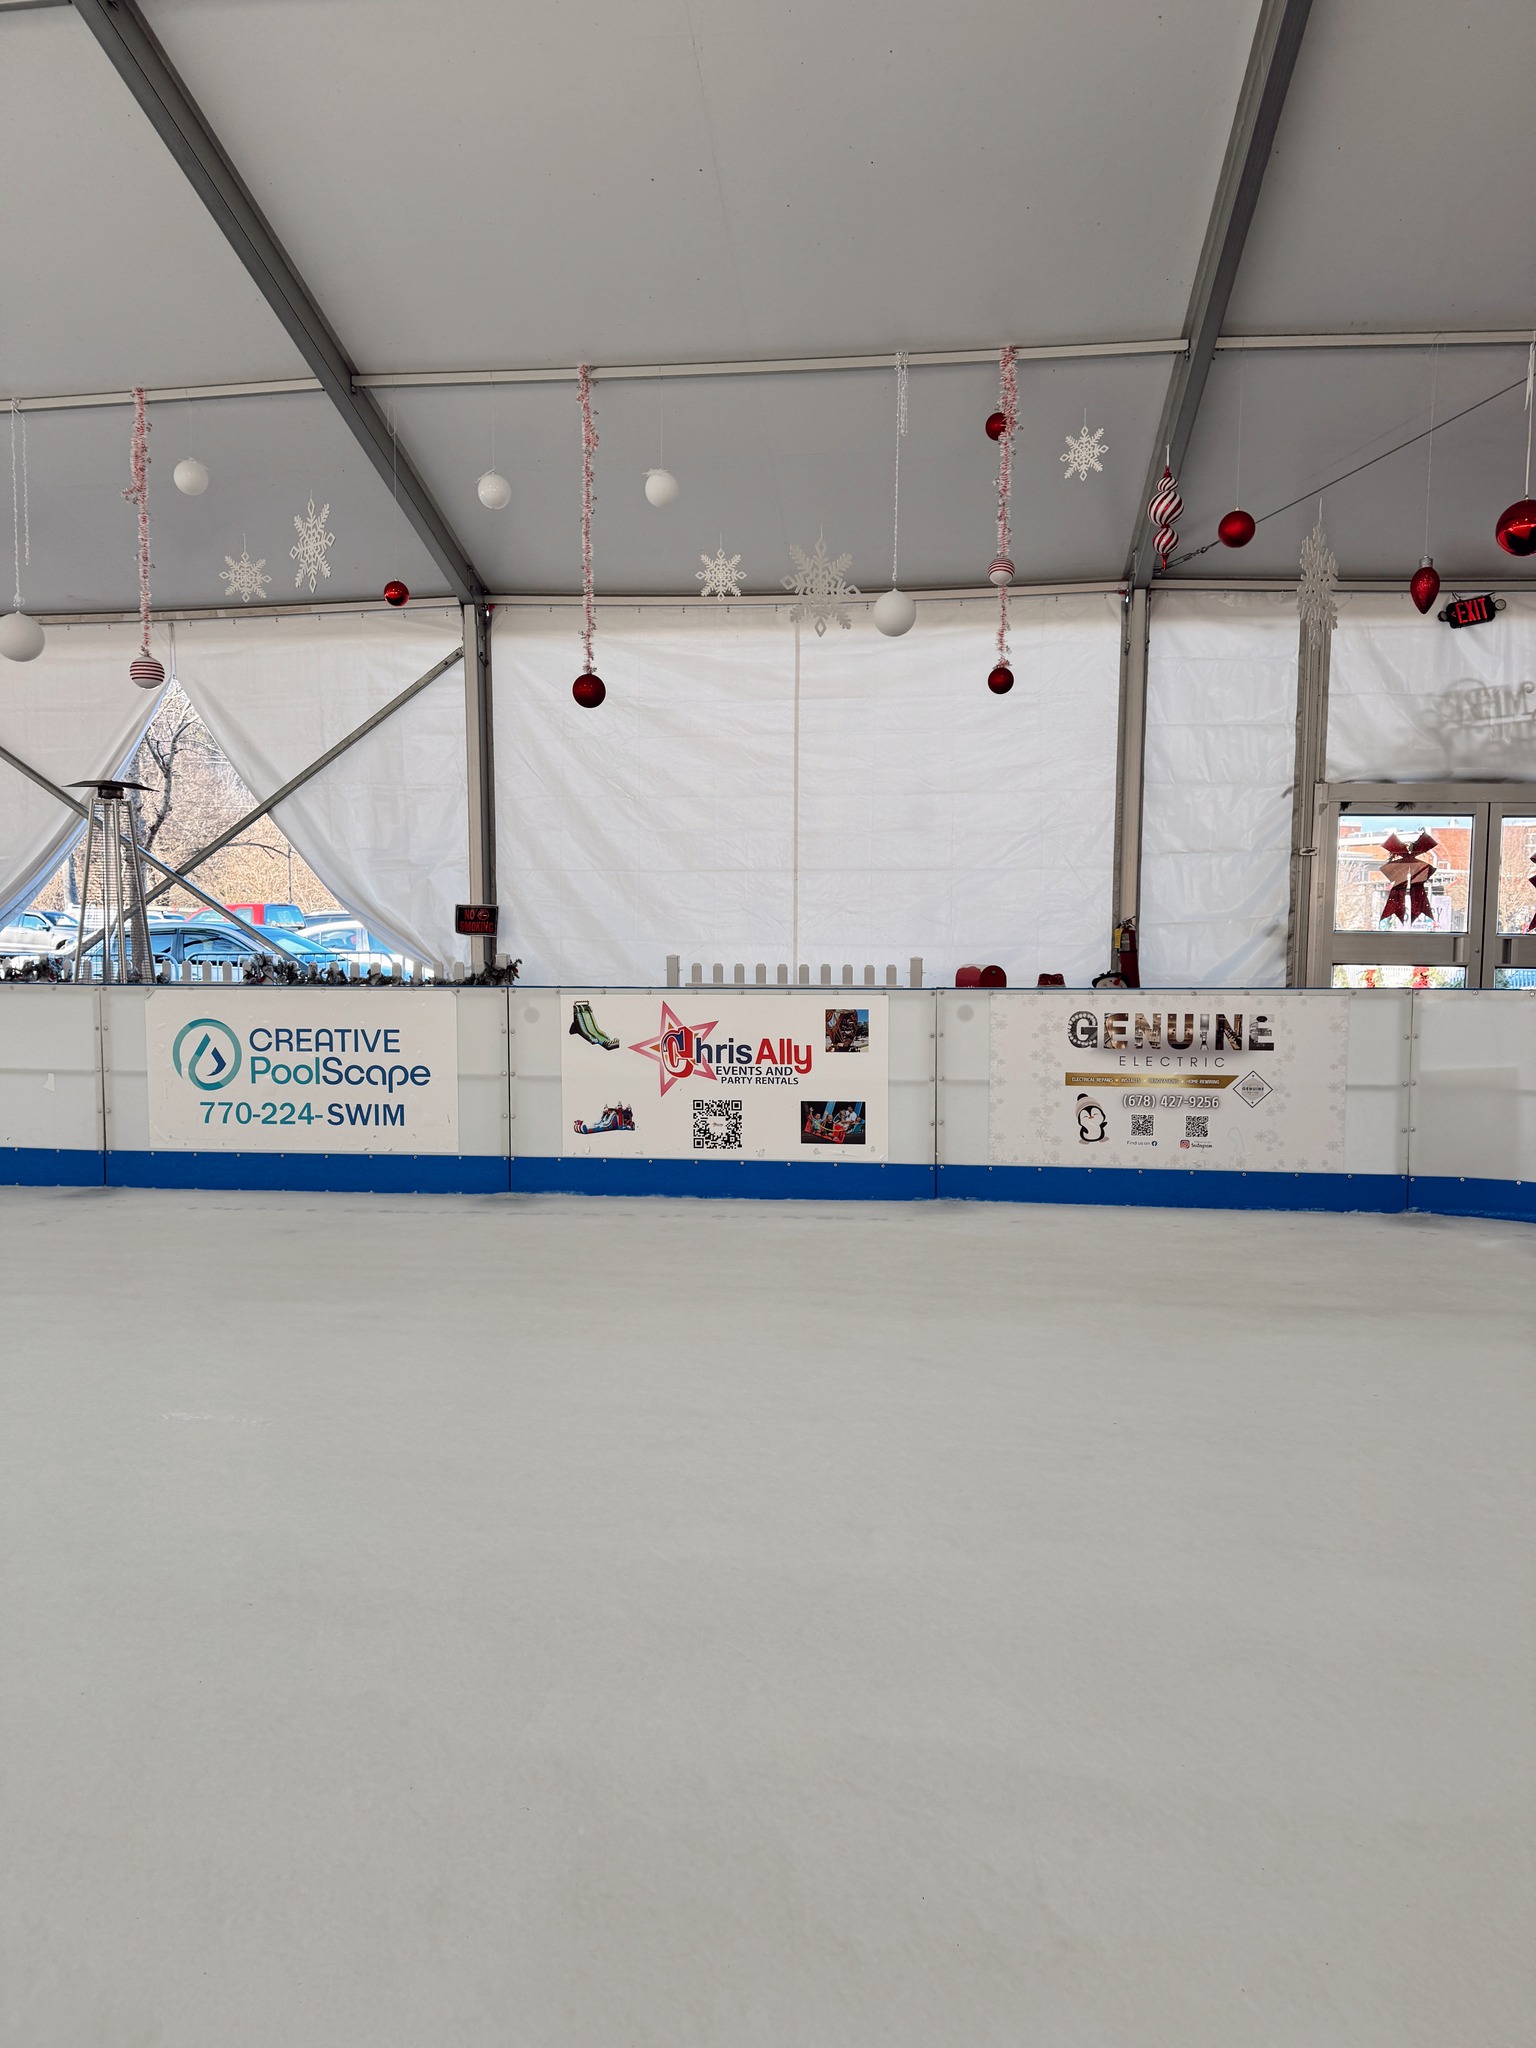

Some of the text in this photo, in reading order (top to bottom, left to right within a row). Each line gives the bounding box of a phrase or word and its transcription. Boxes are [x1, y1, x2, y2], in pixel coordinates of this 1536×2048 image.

[1455, 597, 1488, 624] EXIT
[464, 909, 475, 920] NO
[459, 920, 494, 932] SMOKING
[1067, 1010, 1275, 1051] GENUINE
[249, 1027, 400, 1053] CREATIVE
[1119, 1055, 1225, 1068] ELECTRIC
[250, 1056, 431, 1093] PoolScape
[715, 1065, 793, 1076] EVENTS AND
[721, 1076, 799, 1085] PARTY RENTALS
[1122, 1093, 1220, 1109] (678) 427-9256
[199, 1101, 405, 1127] 770-224-SWIM
